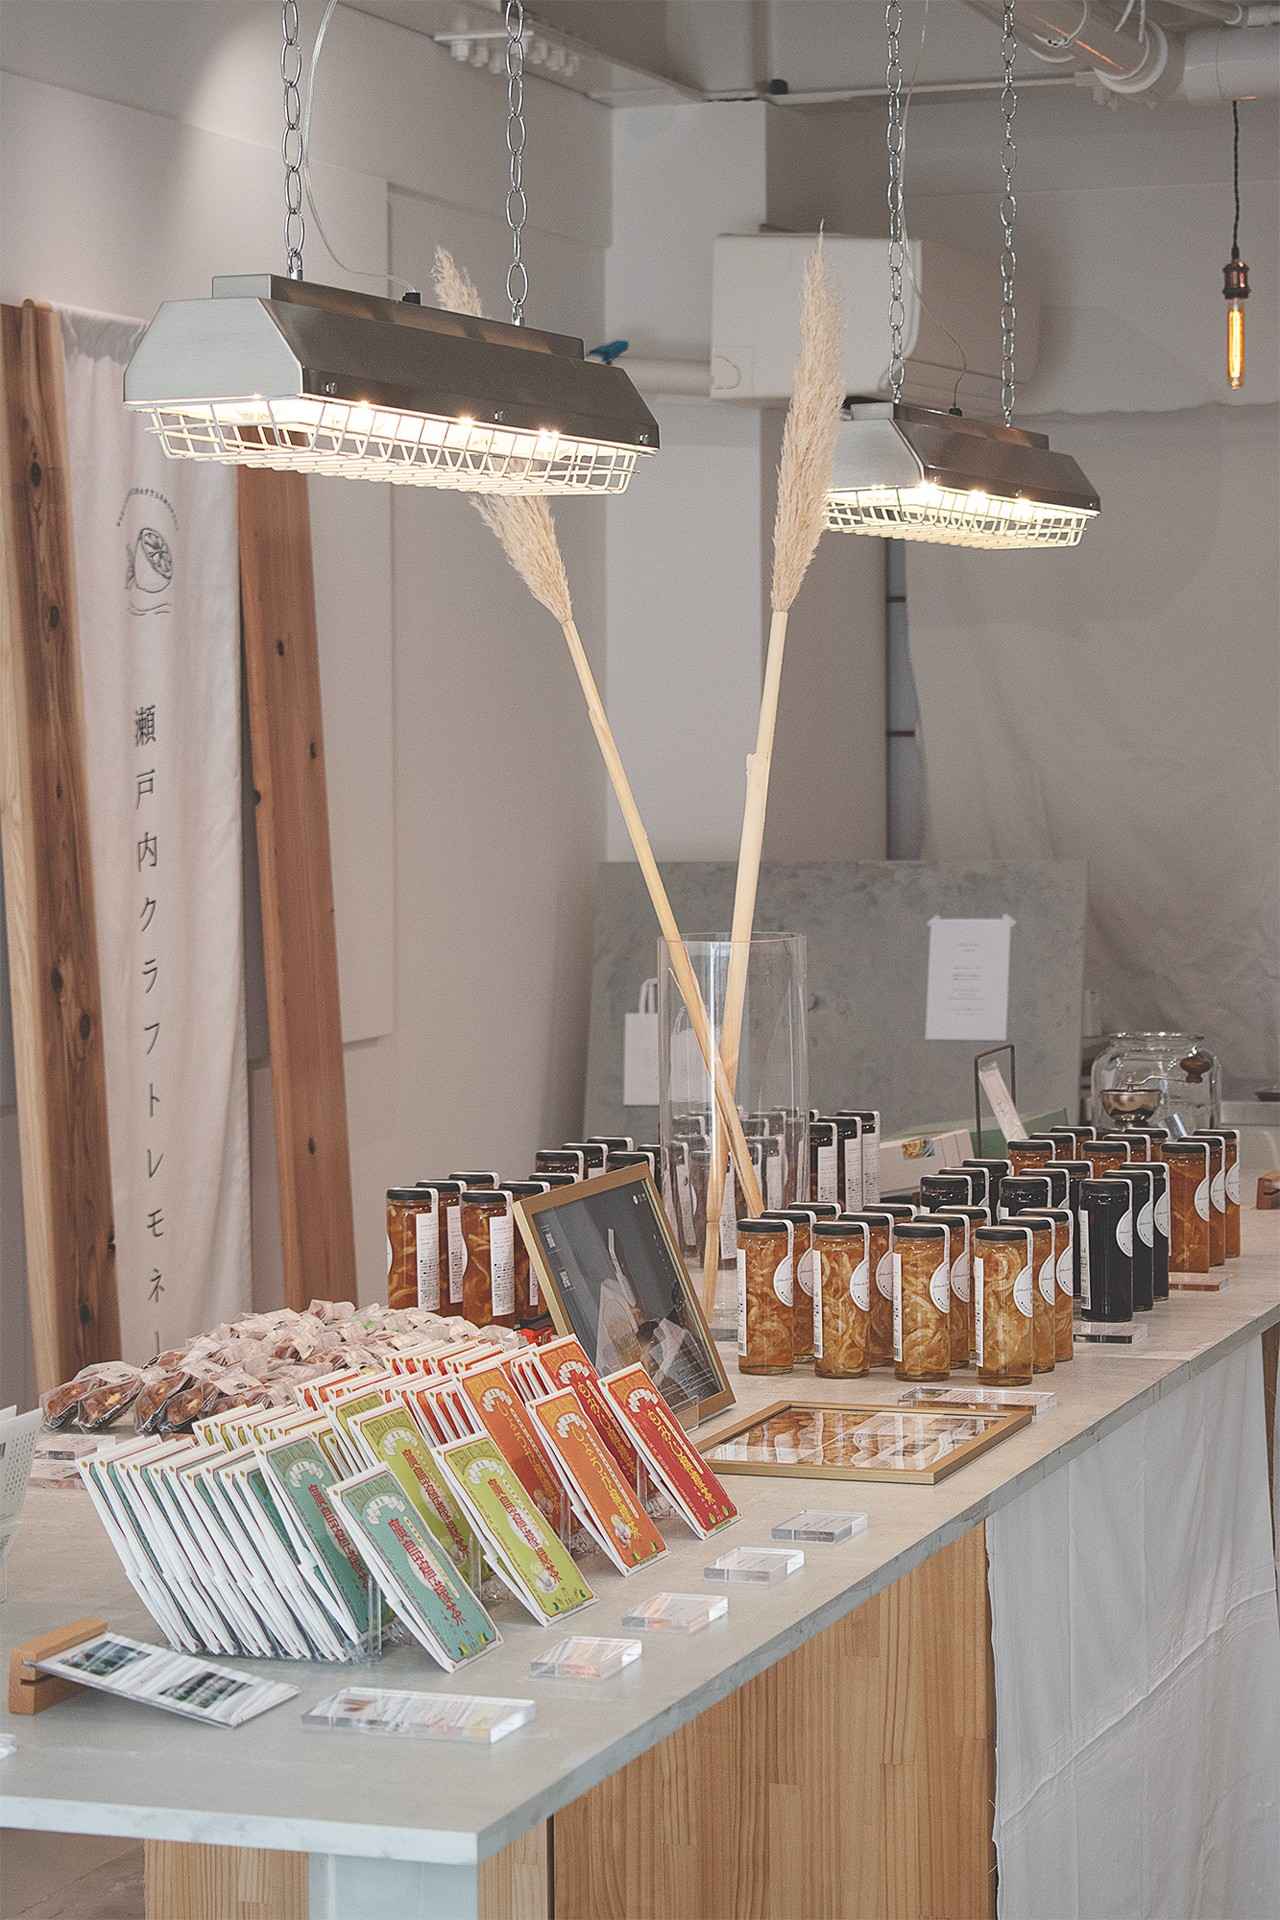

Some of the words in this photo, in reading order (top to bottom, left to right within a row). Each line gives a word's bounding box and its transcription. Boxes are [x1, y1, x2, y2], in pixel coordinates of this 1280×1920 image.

[135, 704, 165, 1355] 瀬戸内クラフトレモネー
